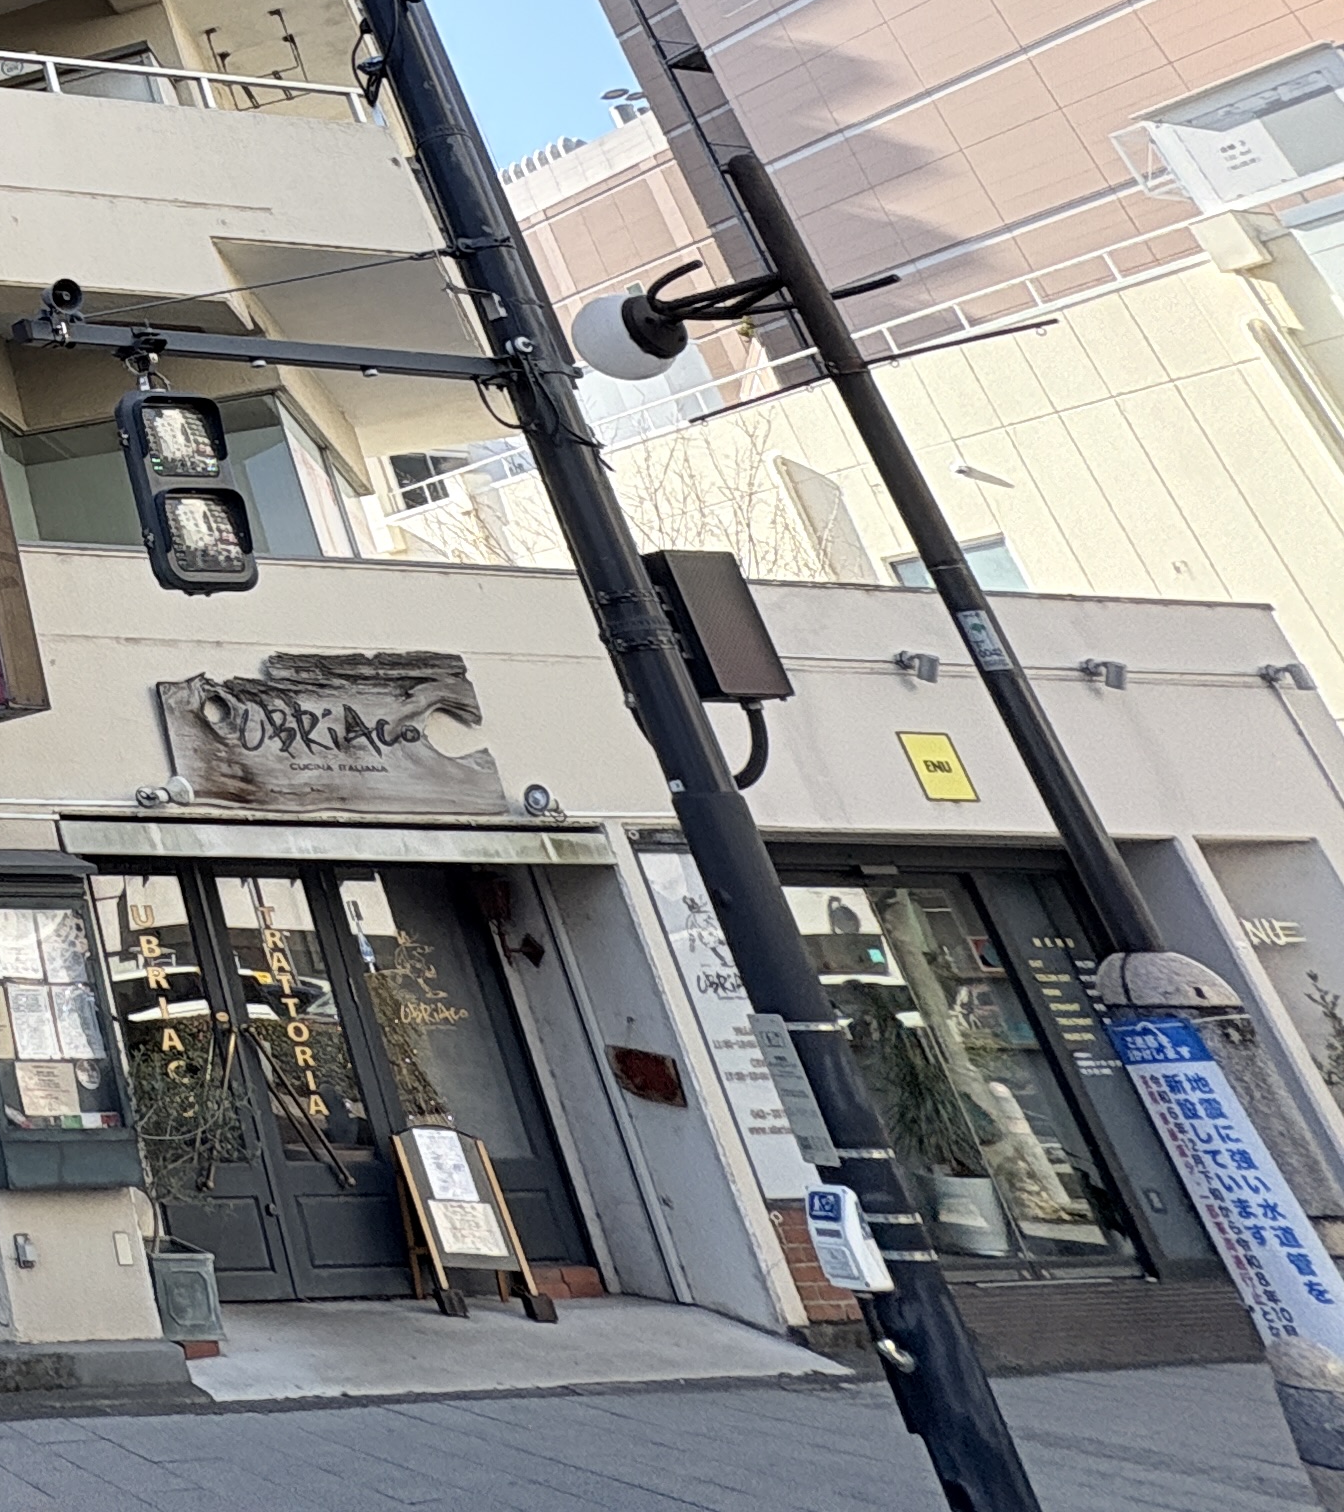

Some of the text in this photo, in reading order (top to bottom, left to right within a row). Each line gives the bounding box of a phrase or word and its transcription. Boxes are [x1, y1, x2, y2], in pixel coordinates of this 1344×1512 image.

[288, 762, 389, 774] CUCINA ITALIANA
[923, 759, 953, 773] ENU
[259, 905, 331, 1117] TRATTORIA
[1161, 1073, 1268, 1247] 新設しています
[1183, 1072, 1335, 1305] 地震に強い水道管を
